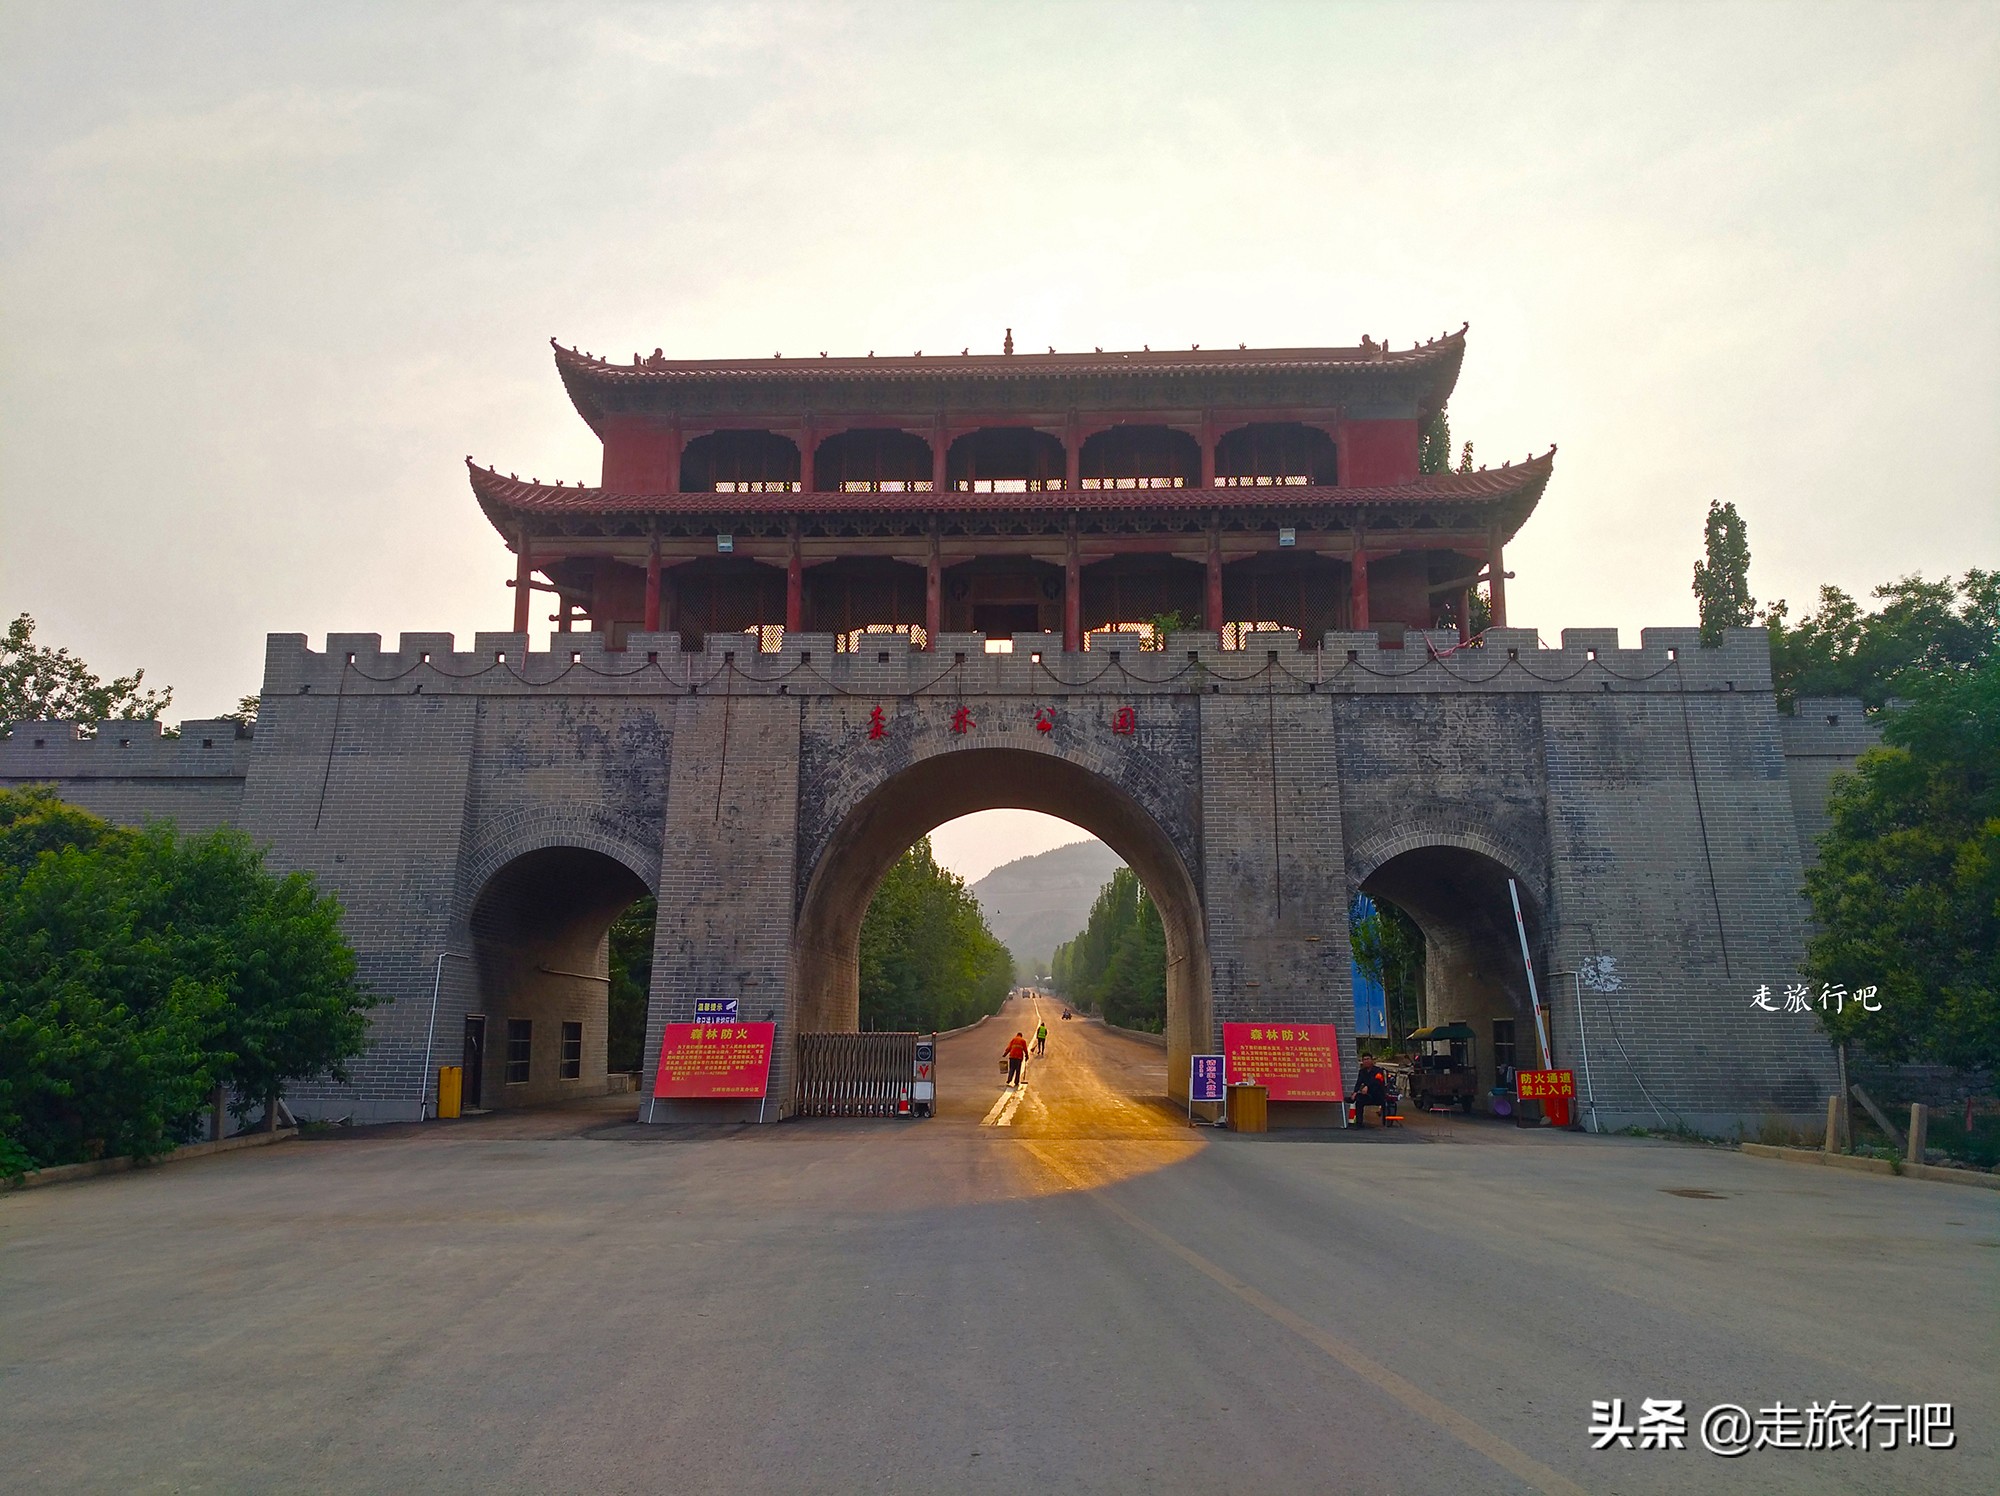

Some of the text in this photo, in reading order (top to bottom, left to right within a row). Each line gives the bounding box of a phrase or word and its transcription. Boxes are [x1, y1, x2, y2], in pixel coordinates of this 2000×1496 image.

[690, 1029, 748, 1039] 森林防火
[1250, 1029, 1310, 1041] 森林防火
[1521, 1073, 1571, 1084] 防火通道
[1521, 1084, 1572, 1096] 禁止入内
